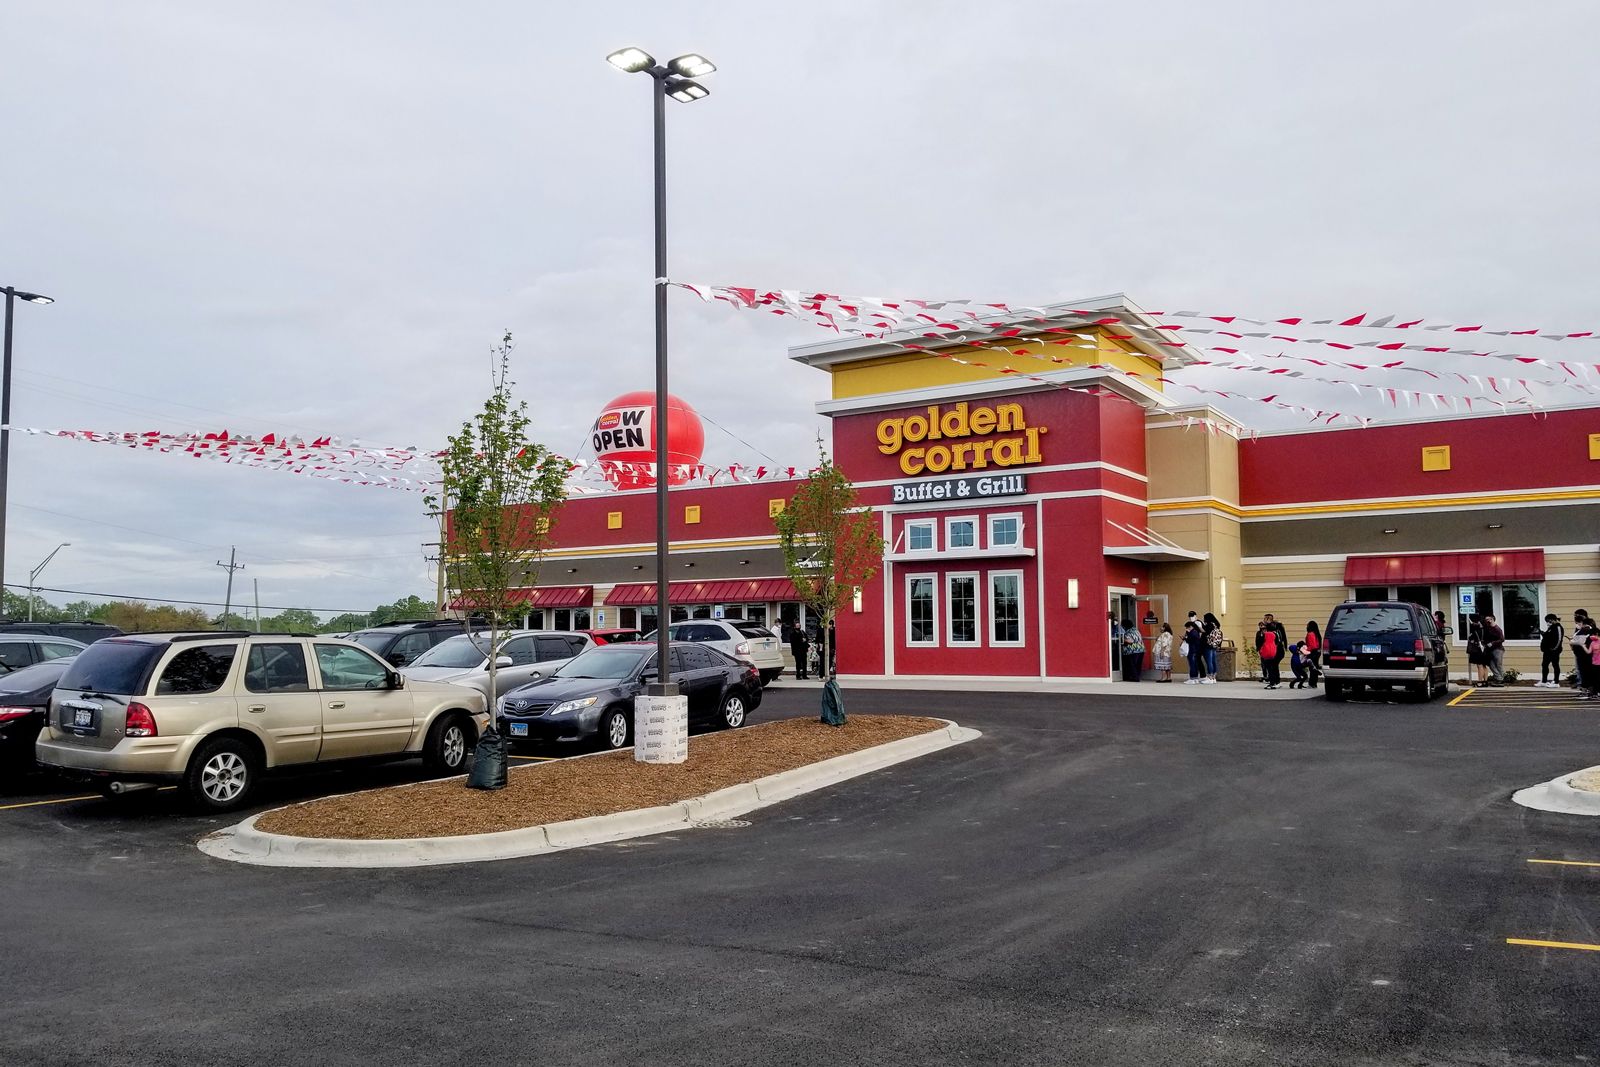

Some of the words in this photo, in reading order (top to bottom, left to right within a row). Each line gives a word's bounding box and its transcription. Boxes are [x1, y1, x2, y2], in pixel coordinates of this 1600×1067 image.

[592, 427, 645, 452] OPEN
[876, 401, 1025, 454] golden
[899, 427, 1042, 475] corral
[893, 482, 951, 501] Buffet
[956, 479, 971, 497] &
[976, 475, 1023, 495] Grill
